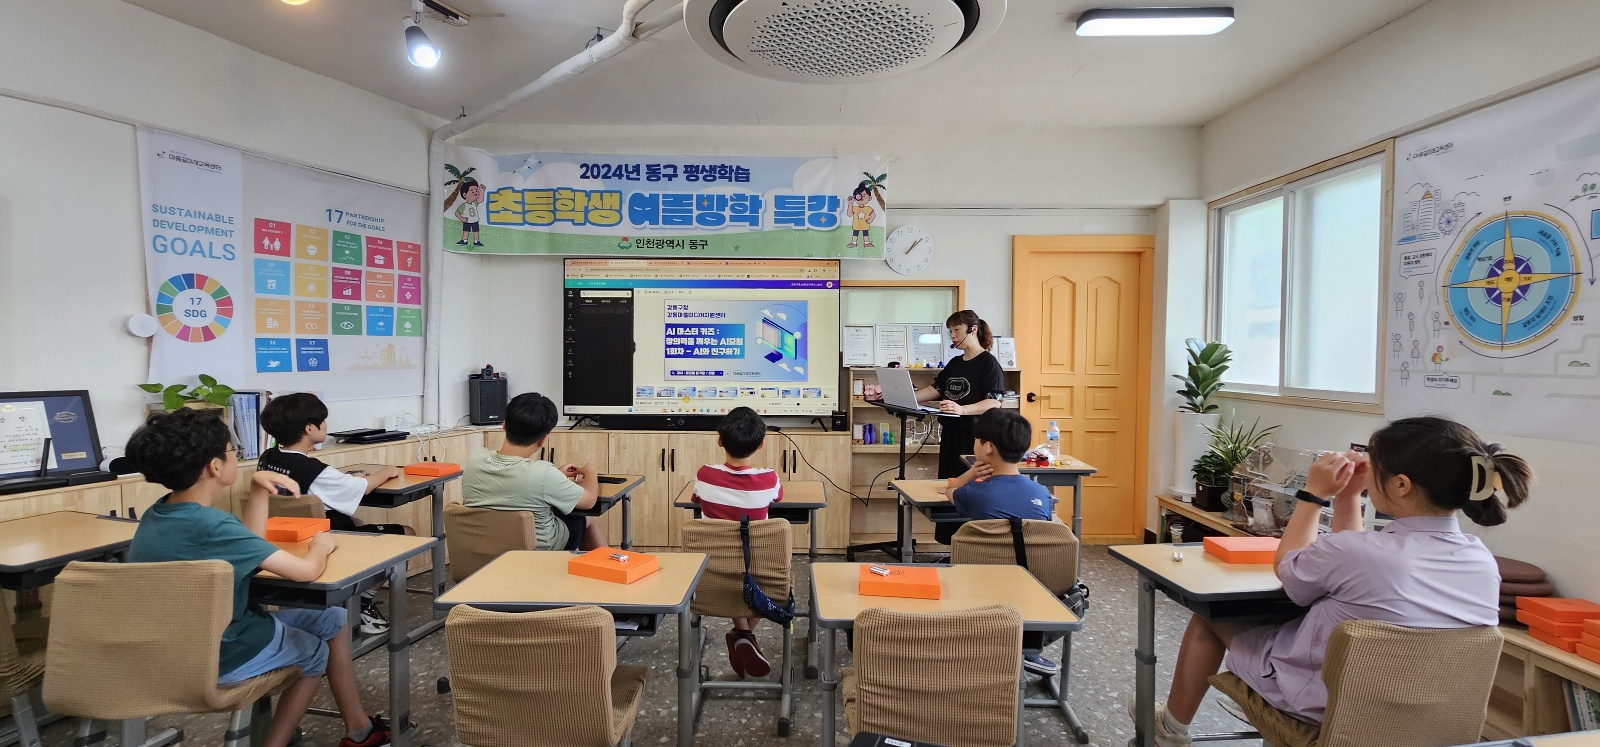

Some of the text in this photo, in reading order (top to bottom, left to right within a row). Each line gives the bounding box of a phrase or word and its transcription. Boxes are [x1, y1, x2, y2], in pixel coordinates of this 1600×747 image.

[580, 163, 750, 182] 2024년 동구 평생학습
[152, 204, 234, 224] SUSTAINABLE
[469, 208, 476, 217] 8
[487, 188, 840, 228] 초등학생 여름방학 특강
[326, 209, 344, 223] 17
[346, 212, 384, 222] PARTNERSHIP
[152, 219, 234, 238] DEVELOPMENT
[152, 234, 236, 260] GOALS
[635, 239, 708, 250] 인천광역시 동구
[184, 309, 207, 318] SDG
[693, 348, 710, 356] AI와
[712, 348, 740, 356] 친구하기
